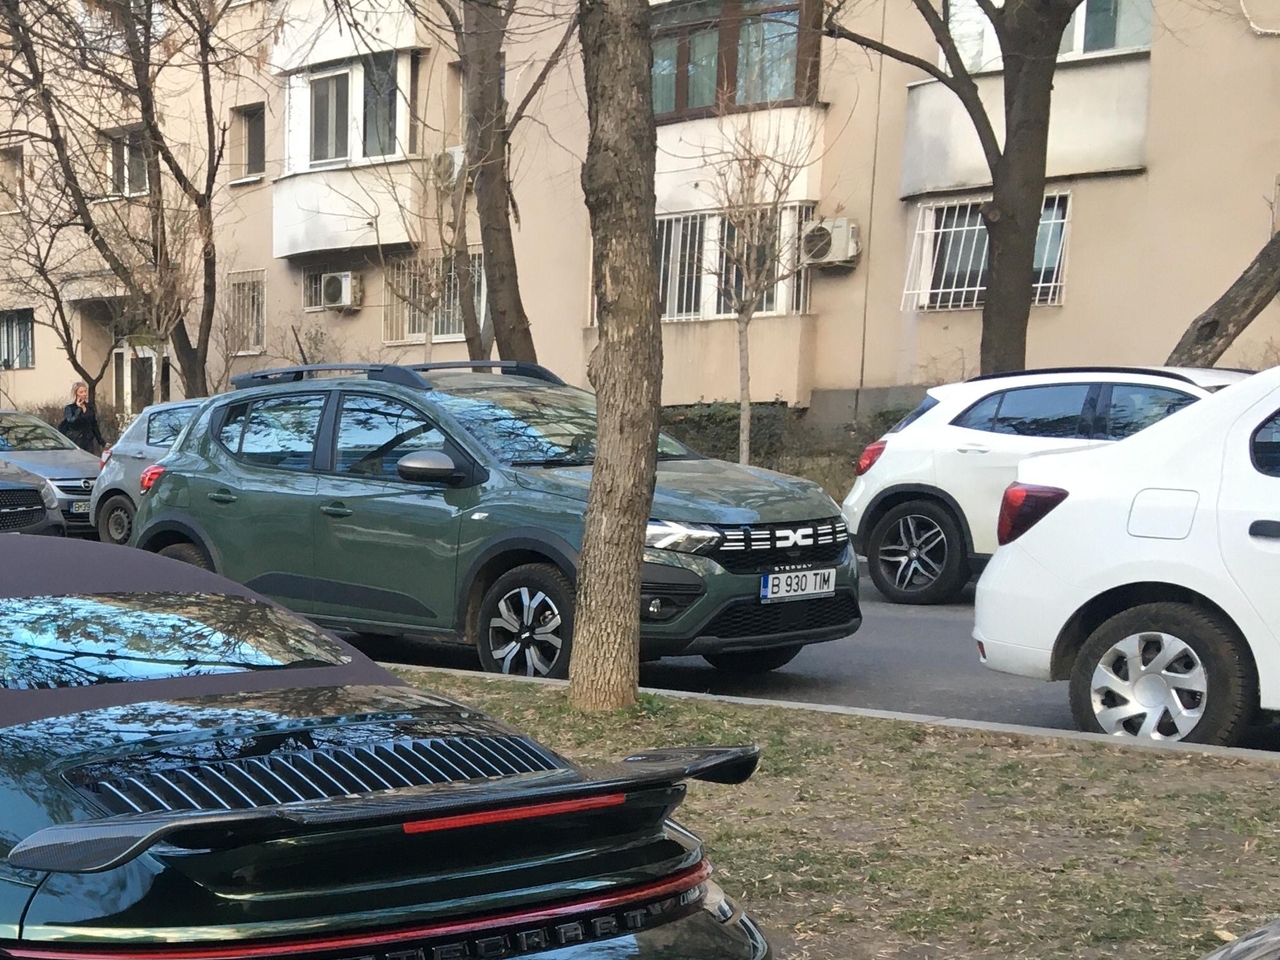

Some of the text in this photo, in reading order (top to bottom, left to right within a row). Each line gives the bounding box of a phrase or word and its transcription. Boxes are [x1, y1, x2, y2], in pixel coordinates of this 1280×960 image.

[771, 572, 831, 594] B 930 TIM
